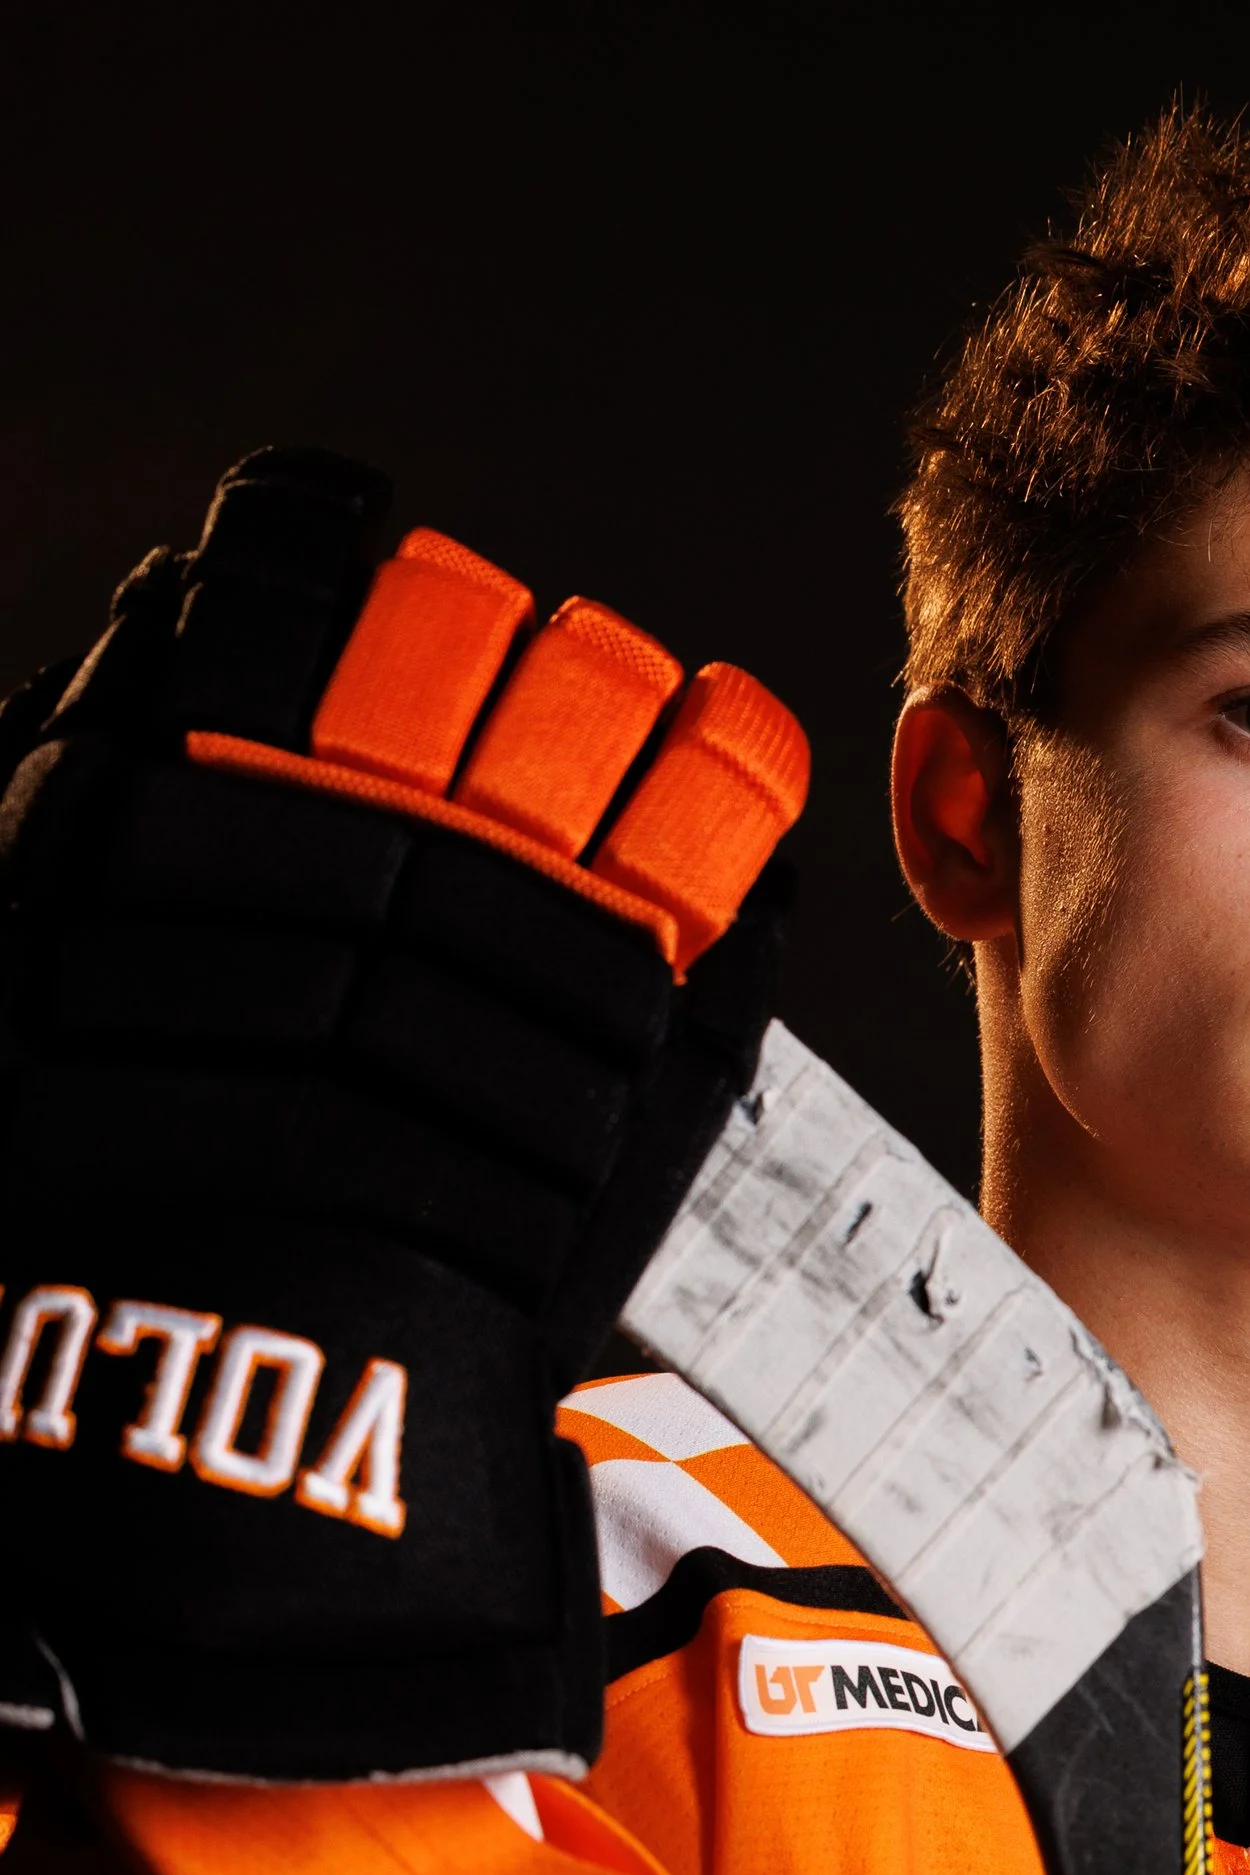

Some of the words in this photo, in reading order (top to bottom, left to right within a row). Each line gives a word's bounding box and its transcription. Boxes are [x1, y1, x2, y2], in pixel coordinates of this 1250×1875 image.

[0, 1283, 408, 1539] VOLU
[754, 1663, 825, 1716] UT
[830, 1664, 988, 1732] MEDIC
